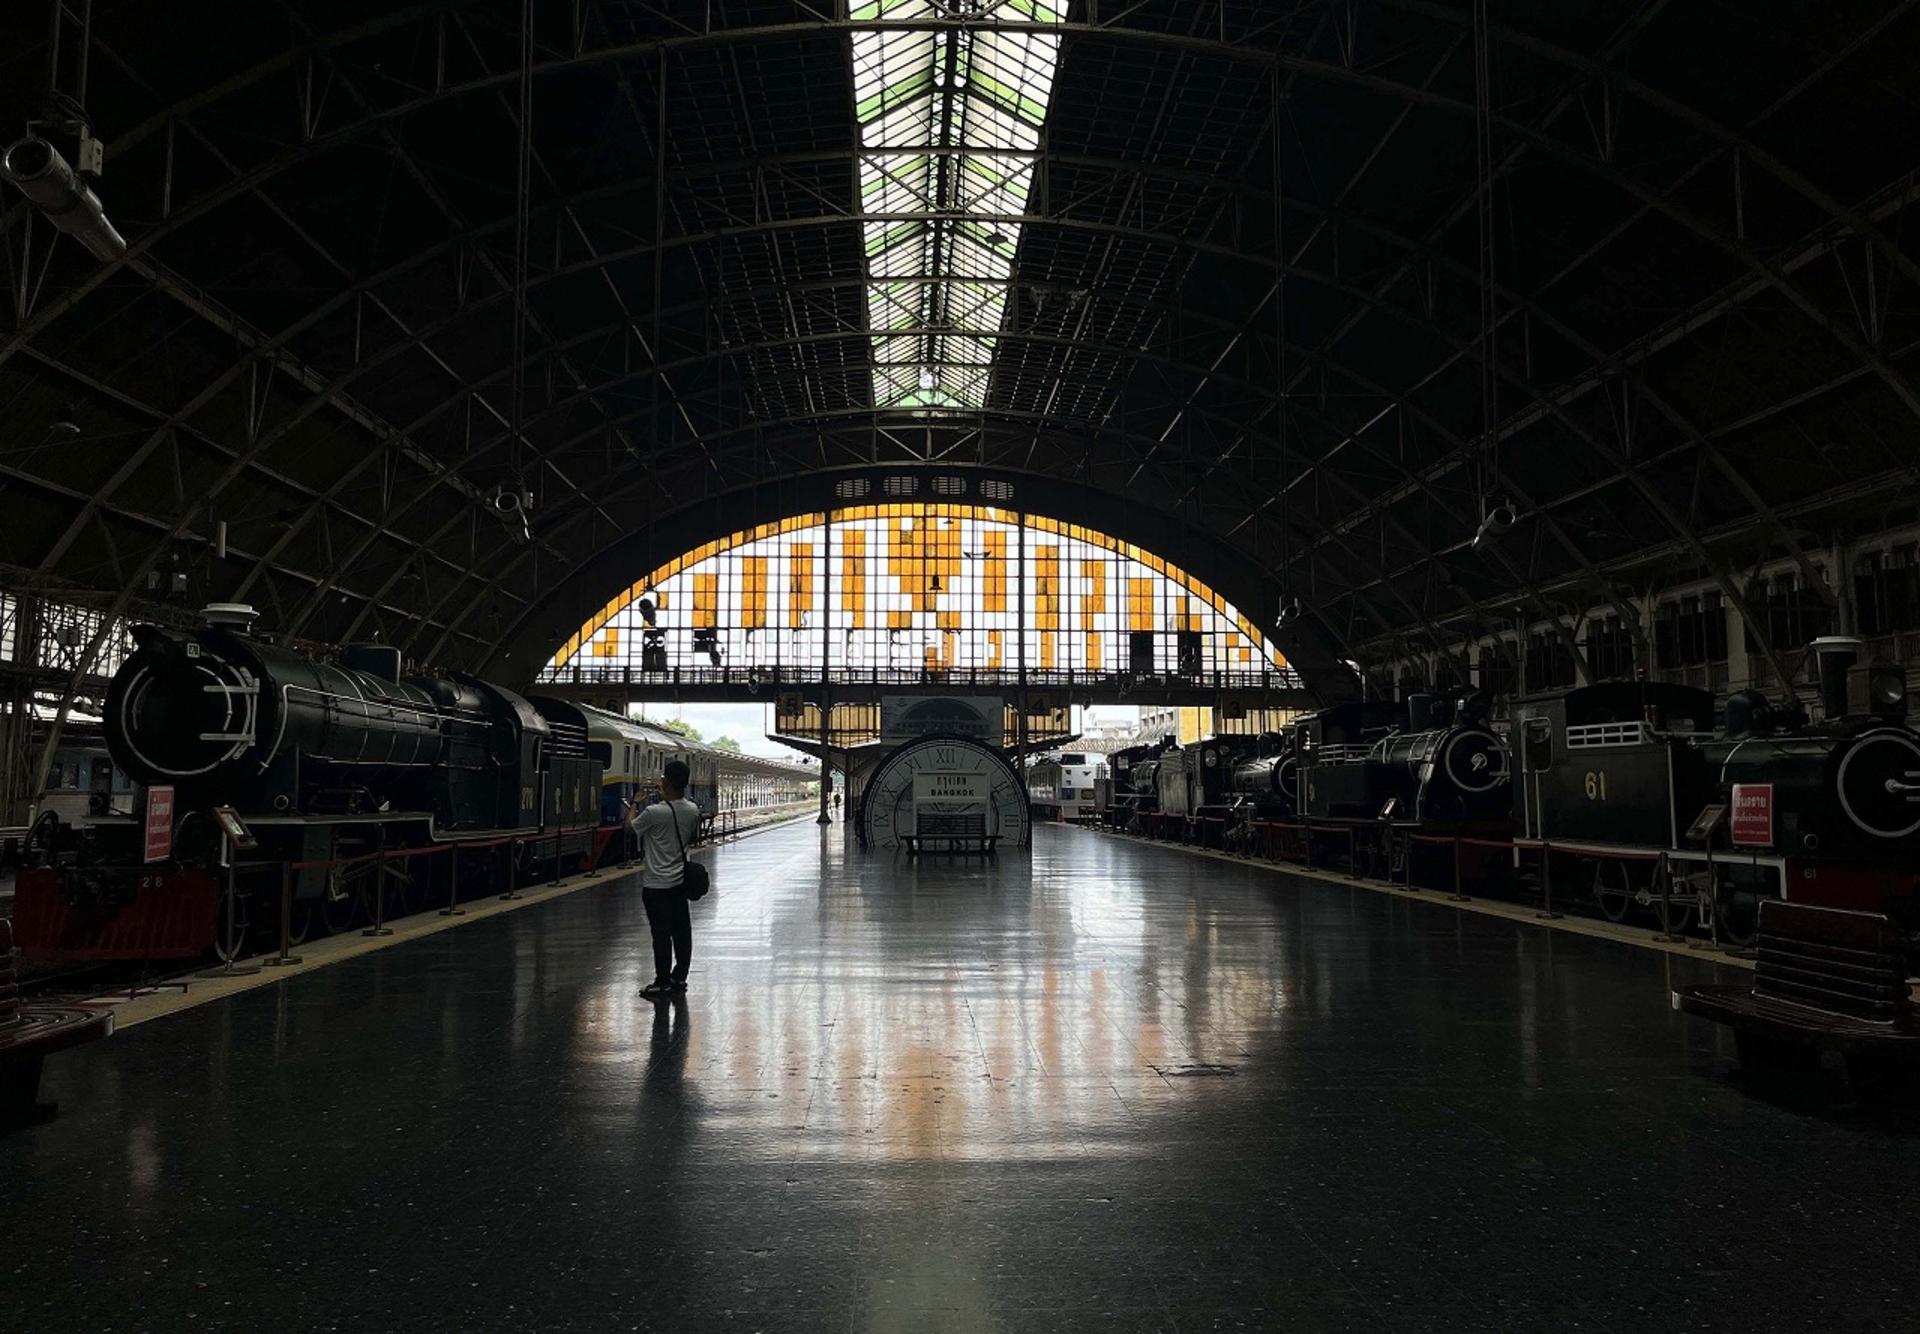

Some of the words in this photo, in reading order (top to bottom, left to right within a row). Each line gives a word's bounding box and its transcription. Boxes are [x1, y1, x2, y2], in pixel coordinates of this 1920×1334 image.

[936, 749, 955, 764] XII
[931, 788, 974, 797] BANGKOK
[1584, 770, 1606, 801] 61
[1803, 867, 1816, 880] 61
